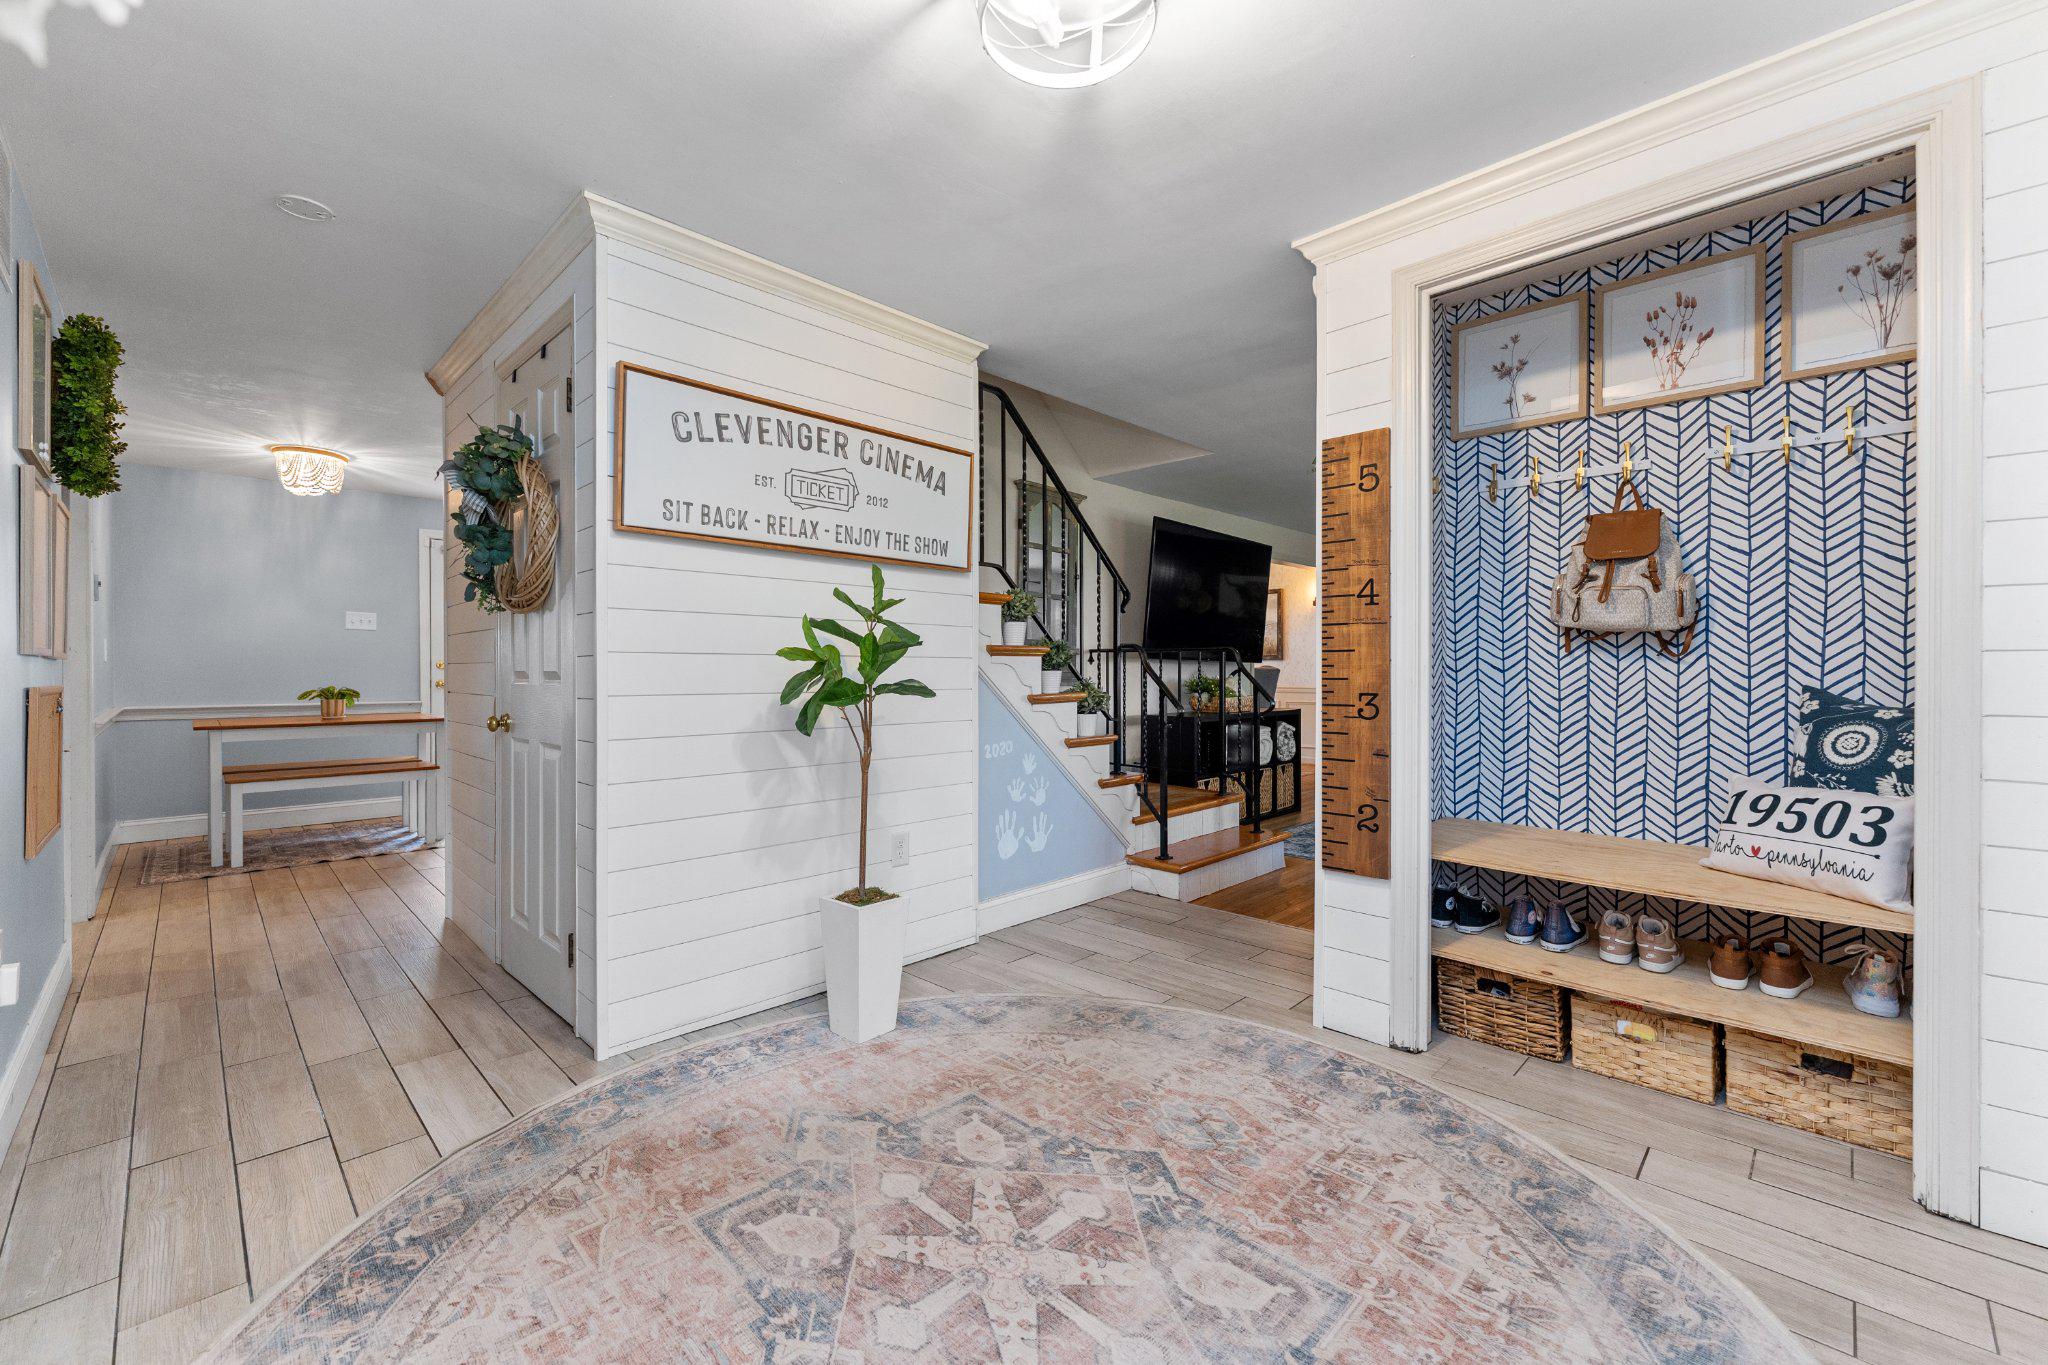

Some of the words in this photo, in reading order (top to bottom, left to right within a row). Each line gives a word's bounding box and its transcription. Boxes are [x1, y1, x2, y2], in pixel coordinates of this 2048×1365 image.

[671, 411, 849, 460] CLEVENGER
[859, 438, 947, 496] CINEMA
[754, 474, 777, 490] EST.
[796, 478, 845, 503] TICKET
[866, 495, 889, 509] 2012
[1358, 463, 1380, 493] 5
[662, 498, 694, 524] SIT
[701, 503, 749, 532] BACK
[766, 513, 819, 541] RELAX
[835, 524, 880, 546] ENJOY
[885, 531, 911, 552] THE
[914, 536, 949, 558] SHOW
[1357, 577, 1380, 606] 4
[1357, 692, 1380, 721] 3
[984, 740, 1014, 759] 2020
[1356, 803, 1380, 834] 2
[1721, 789, 1895, 848] 19503
[1765, 848, 1875, 882] pennsylvania
